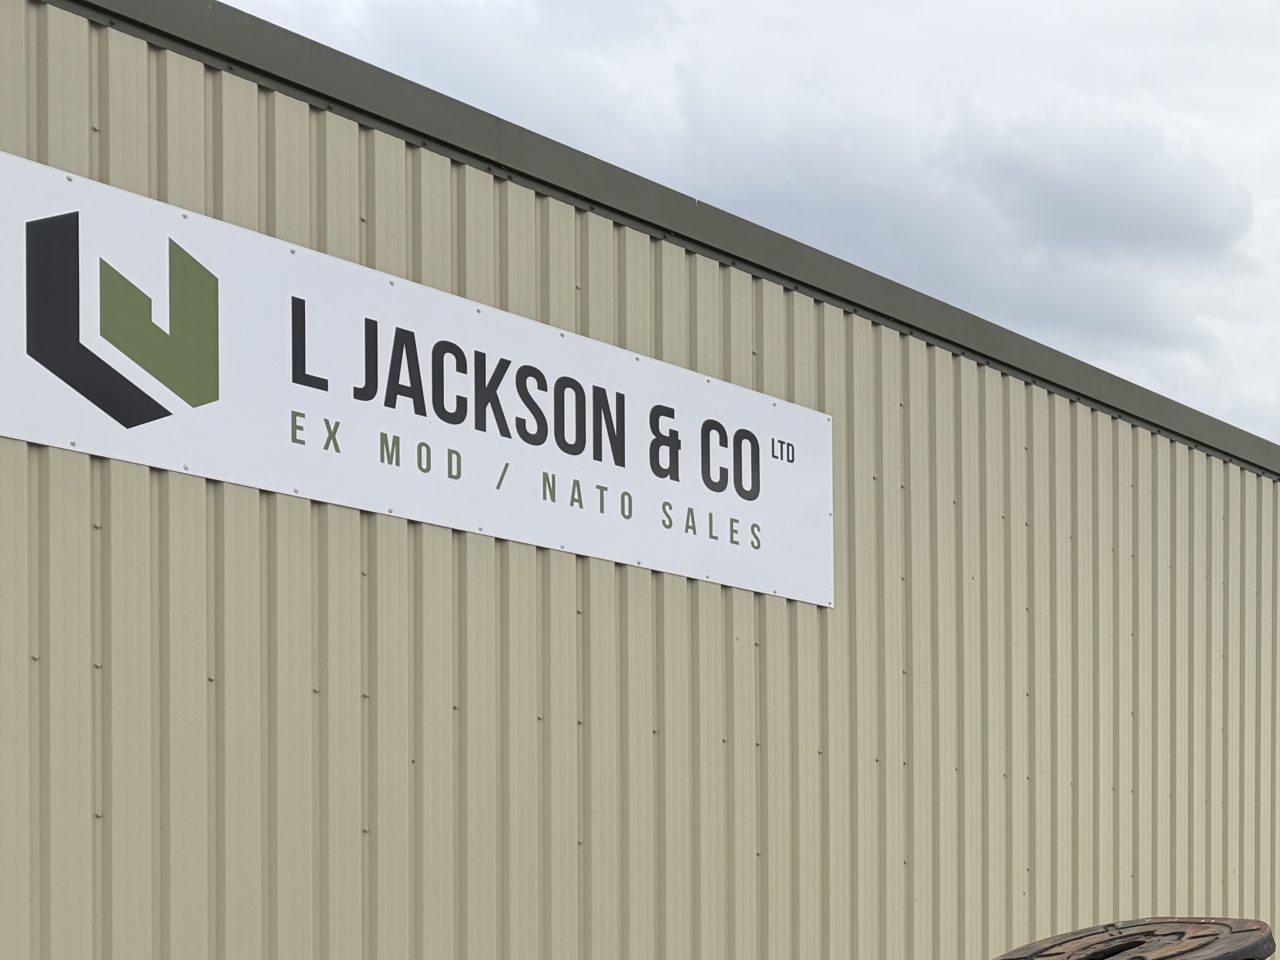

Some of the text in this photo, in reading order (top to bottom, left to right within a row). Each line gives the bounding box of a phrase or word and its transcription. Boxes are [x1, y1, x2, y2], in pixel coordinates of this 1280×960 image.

[290, 410, 341, 454] EX
[379, 431, 462, 481] MOD
[543, 471, 633, 520] NATO
[661, 501, 761, 551] SALES
[291, 296, 795, 502] L JACKSON & CO LTD
